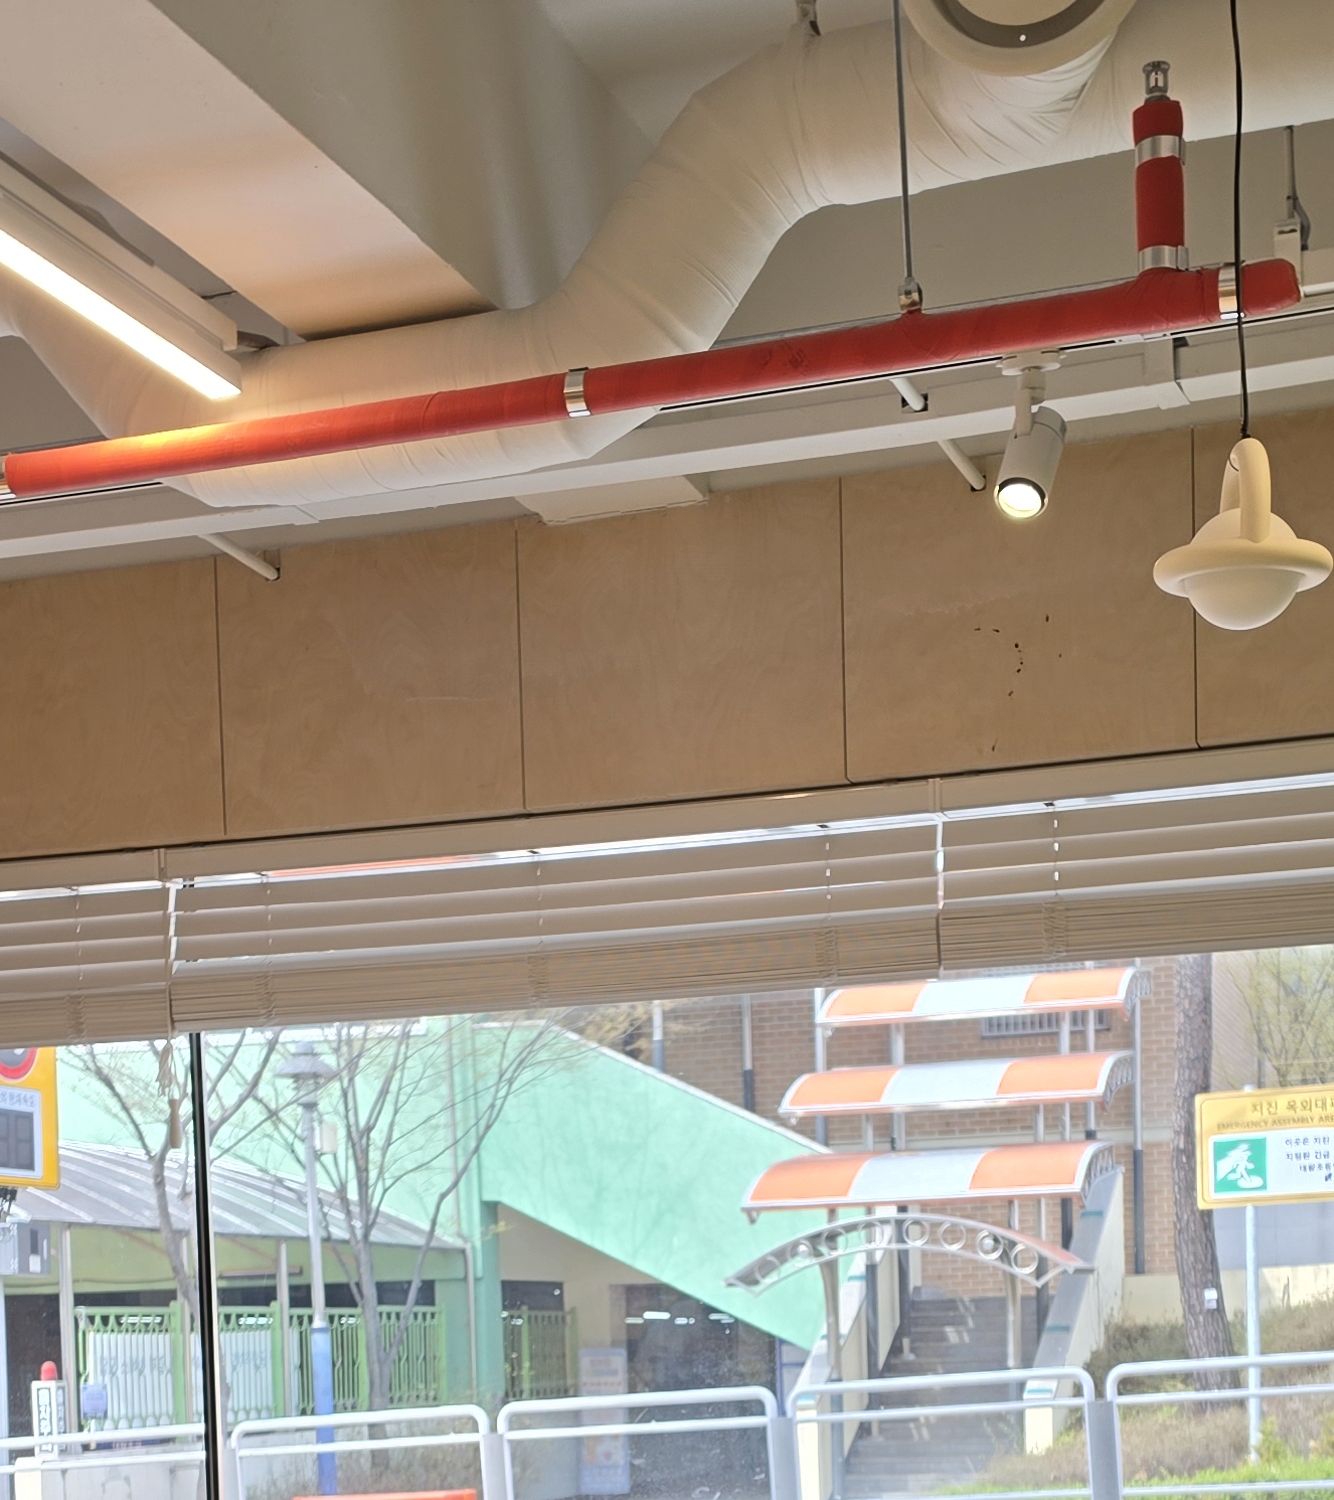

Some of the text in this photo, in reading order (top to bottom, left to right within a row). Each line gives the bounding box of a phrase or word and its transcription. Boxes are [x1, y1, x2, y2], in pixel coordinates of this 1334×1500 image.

[1251, 1101, 1278, 1116] 지진
[1217, 1119, 1269, 1130] EMERGENCY
[1271, 1116, 1317, 1128] ASSEMBLY
